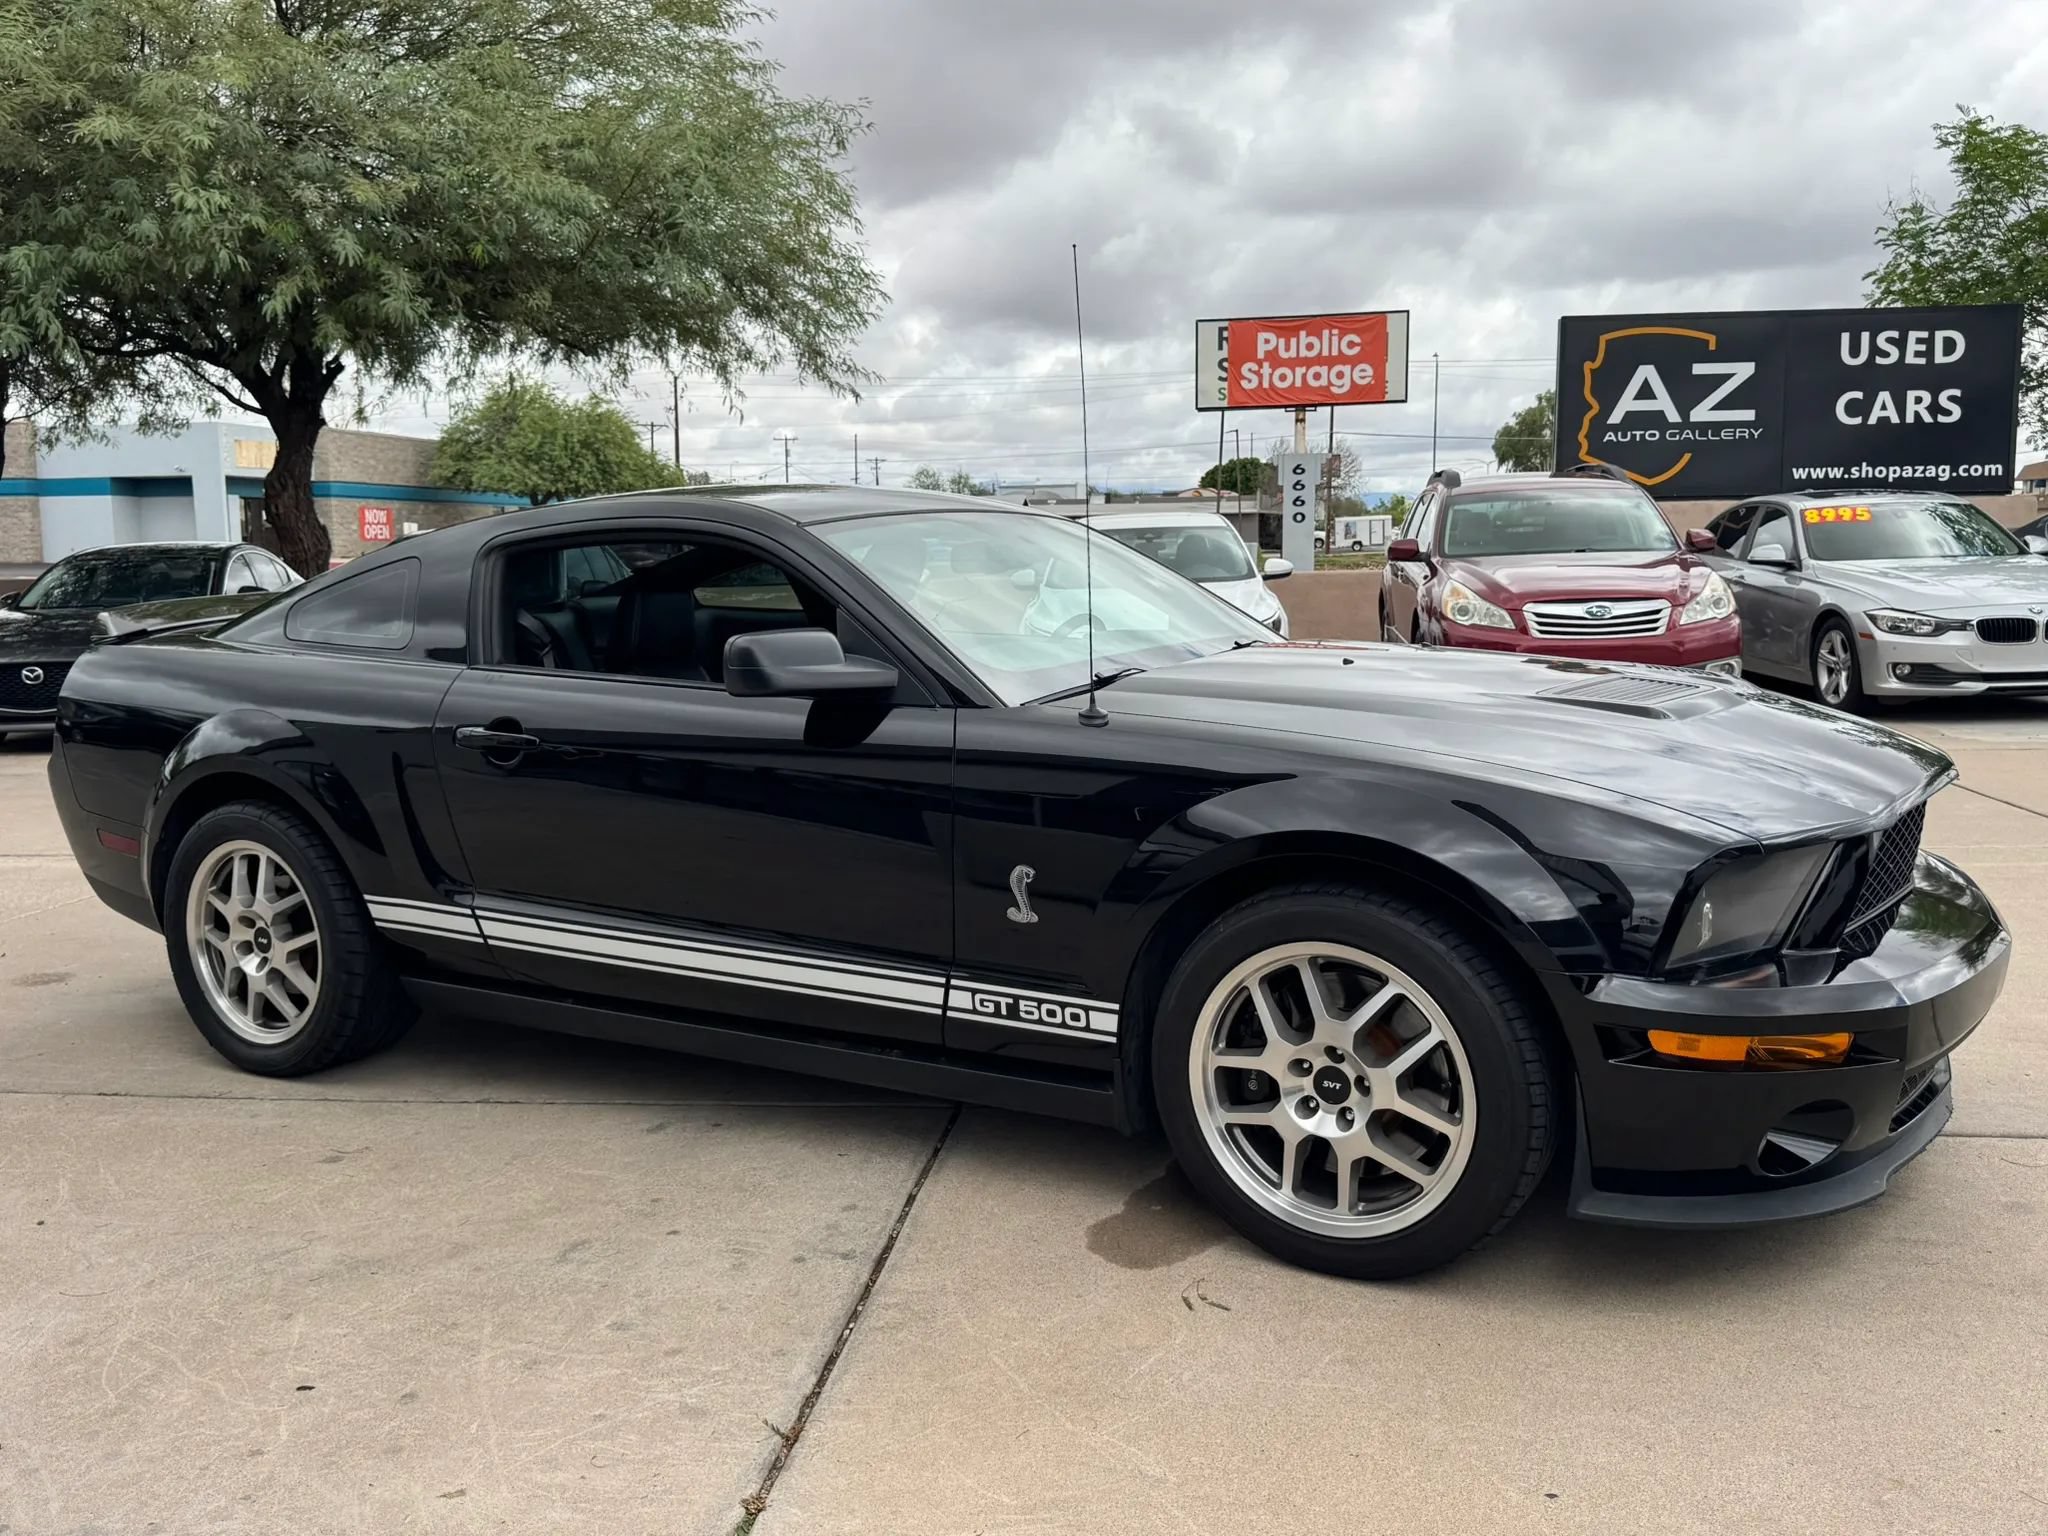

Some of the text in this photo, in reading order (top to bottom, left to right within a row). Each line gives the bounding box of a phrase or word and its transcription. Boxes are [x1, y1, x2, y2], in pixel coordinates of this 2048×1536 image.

[1256, 329, 1362, 360] Public
[1840, 329, 1967, 366] USED
[1240, 361, 1375, 395] Storage
[1606, 361, 1757, 425] AZ
[1835, 388, 1963, 426] CARS
[1603, 428, 1764, 443] AUTO GALLERY
[1792, 462, 2004, 483] www.shopazag.com
[1292, 463, 1306, 524] 6660
[364, 509, 387, 523] NOW
[1804, 506, 1873, 524] 8995
[364, 524, 390, 539] OPEN
[974, 993, 1087, 1028] GT 500
[1322, 1080, 1342, 1090] SVT
